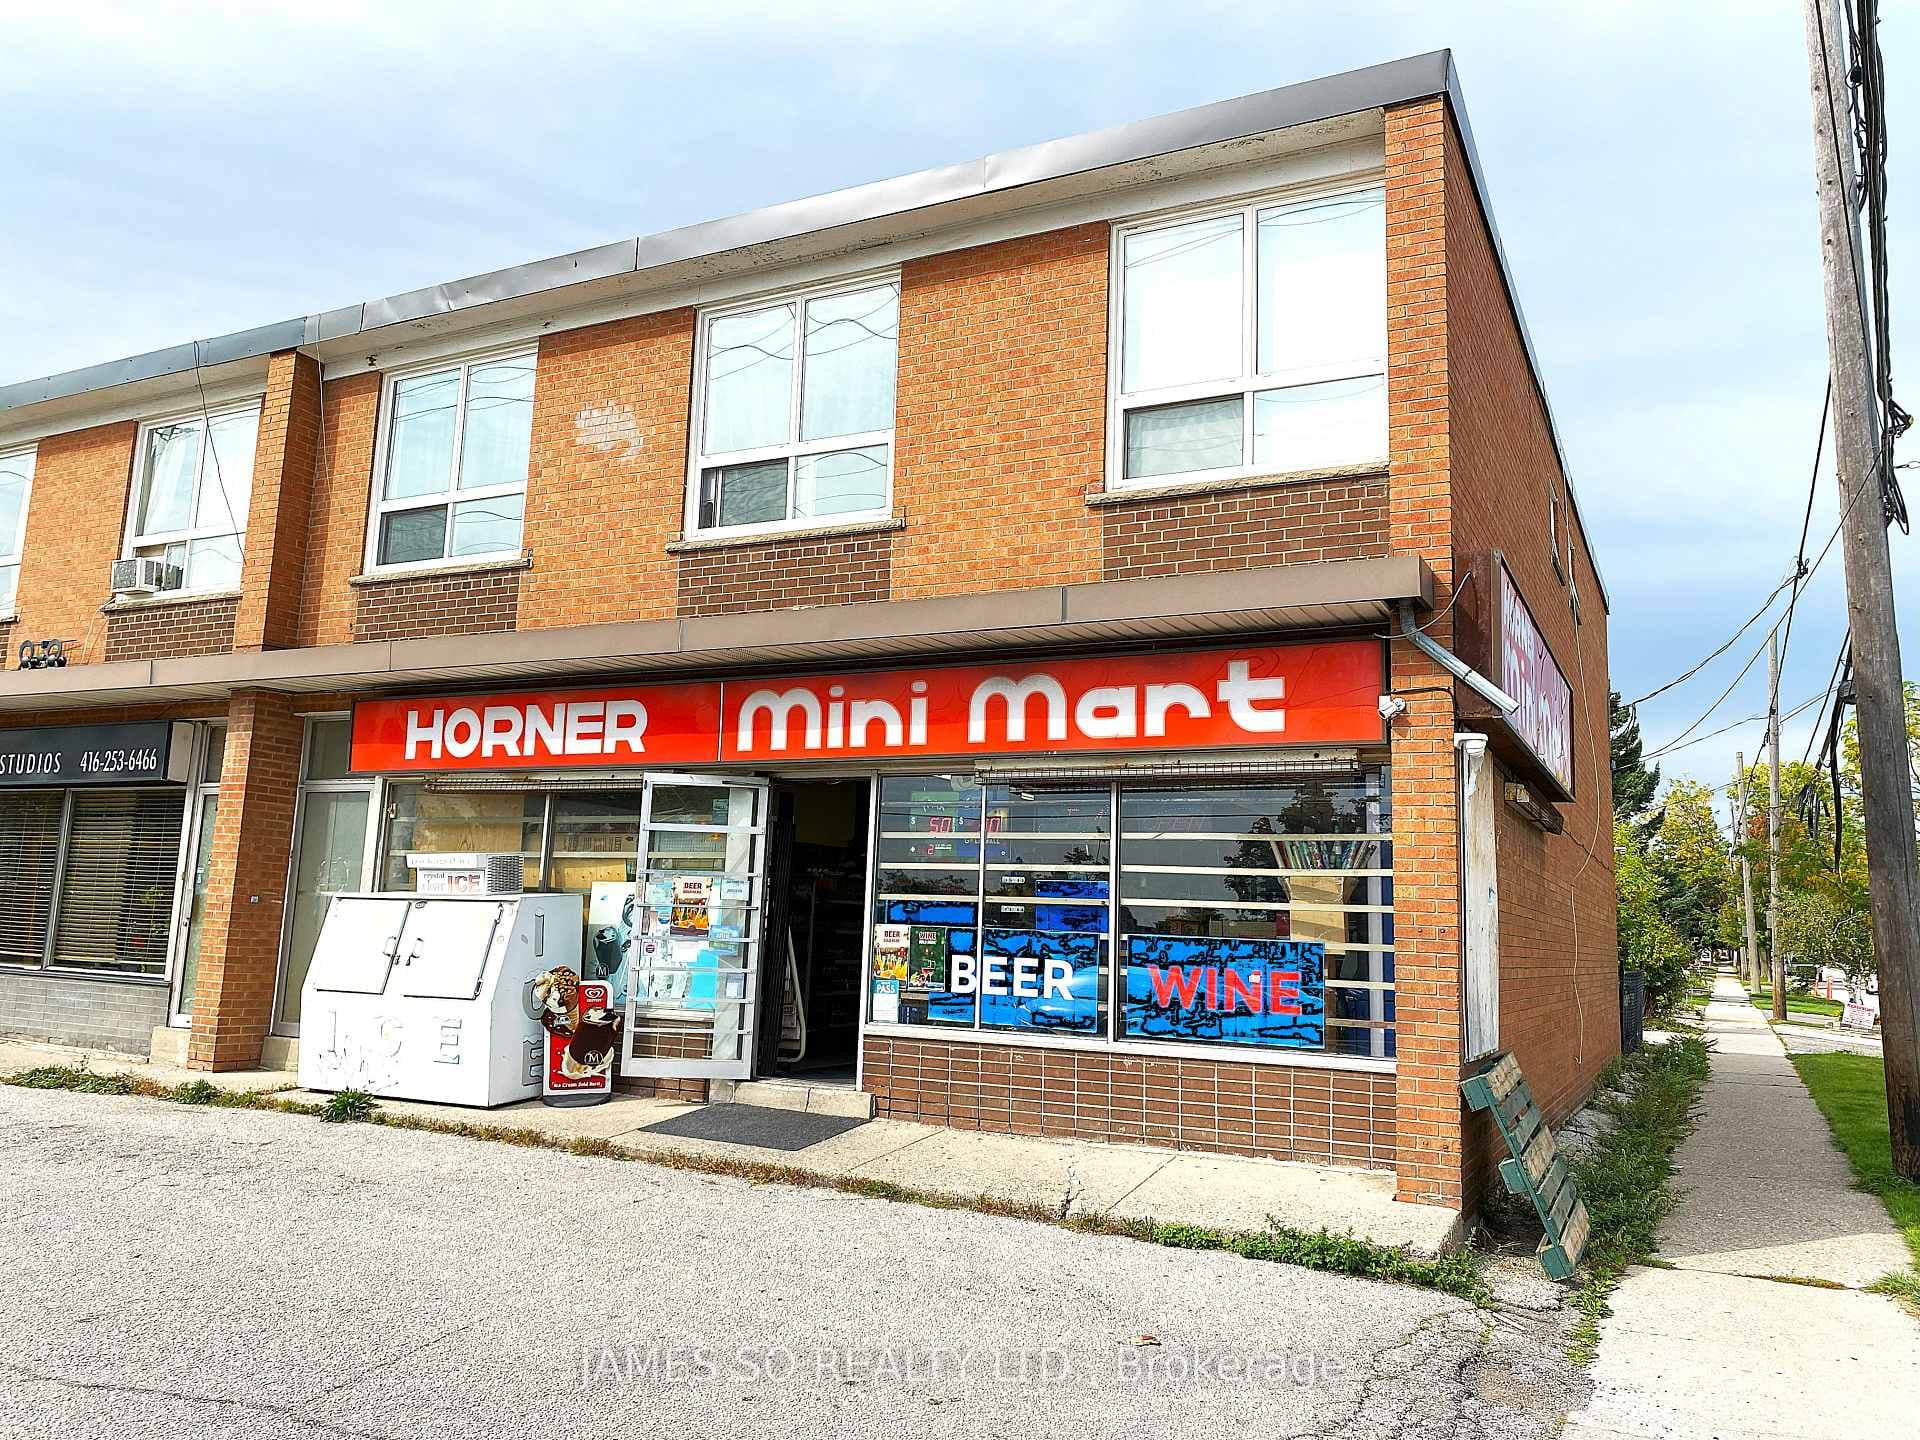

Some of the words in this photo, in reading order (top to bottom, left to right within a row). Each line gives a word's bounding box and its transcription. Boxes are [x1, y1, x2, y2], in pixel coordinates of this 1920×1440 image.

[404, 699, 648, 760] HORNER
[967, 659, 1287, 742] Mart
[0, 752, 62, 775] STUDIOS
[79, 748, 157, 772] 416-253-6466
[447, 873, 481, 894] ICE
[684, 882, 702, 890] BEER
[884, 930, 901, 938] BEER
[918, 931, 937, 940] WINE
[951, 953, 1074, 1001] BEER
[876, 983, 896, 993] PASS
[1148, 964, 1303, 1015] WINE
